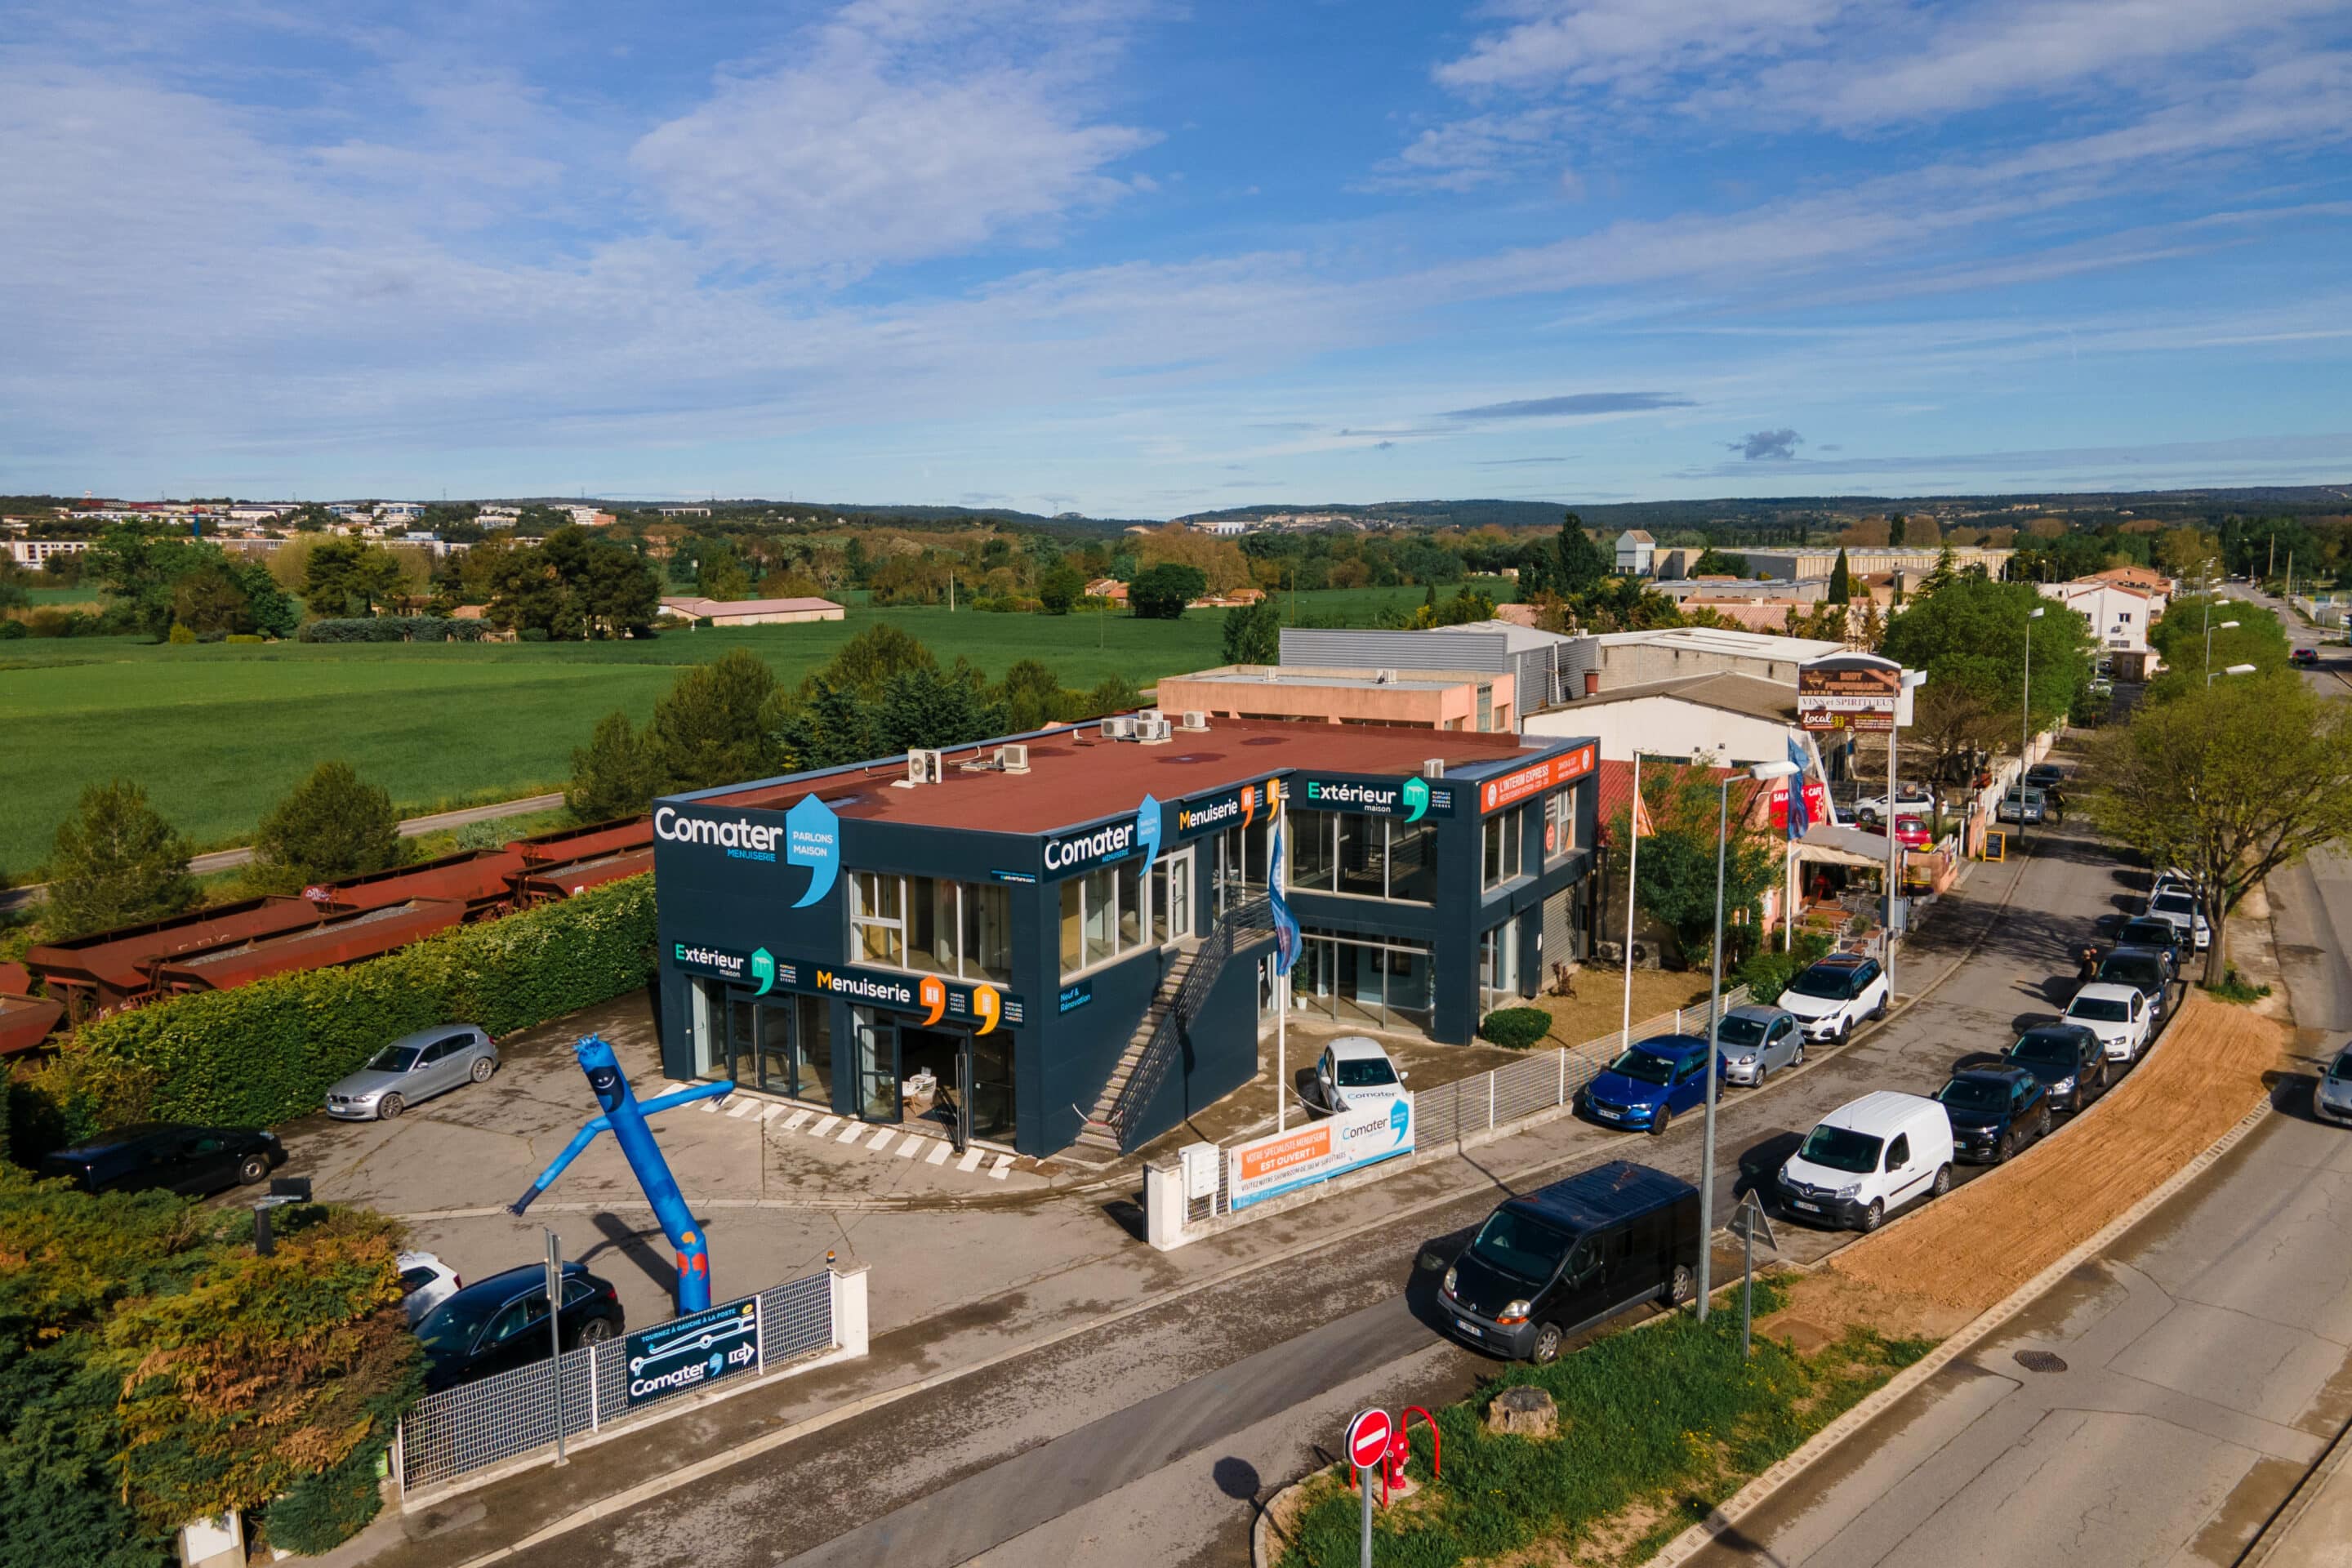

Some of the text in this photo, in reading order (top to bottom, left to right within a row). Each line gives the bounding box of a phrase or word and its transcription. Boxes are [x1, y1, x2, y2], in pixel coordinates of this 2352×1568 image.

[1526, 764, 1549, 782] EXPRESS
[1308, 782, 1396, 804] Extérieur
[1179, 798, 1238, 830] Menuiserie
[1364, 803, 1391, 813] maison
[655, 806, 783, 851] Comater
[793, 831, 833, 844] PARLONS
[727, 849, 776, 862] MENUISERIE
[793, 845, 827, 857] MAISON
[1045, 824, 1134, 870] Comater
[675, 944, 744, 969] Extérieur
[719, 969, 740, 978] maison
[816, 970, 911, 1003] Menuiserie
[1060, 989, 1074, 1003] Neuf
[1348, 1091, 1396, 1100] Comater
[1342, 1117, 1388, 1140] Comater
[1261, 1159, 1276, 1172] EST
[1277, 1149, 1310, 1165] OUVERT
[641, 1330, 670, 1343] TOURNEZ
[677, 1319, 702, 1332] GAUCHE
[708, 1313, 716, 1322] LA
[717, 1308, 736, 1319] POSTE
[731, 1349, 749, 1361] ICI
[630, 1361, 708, 1396] Comater
